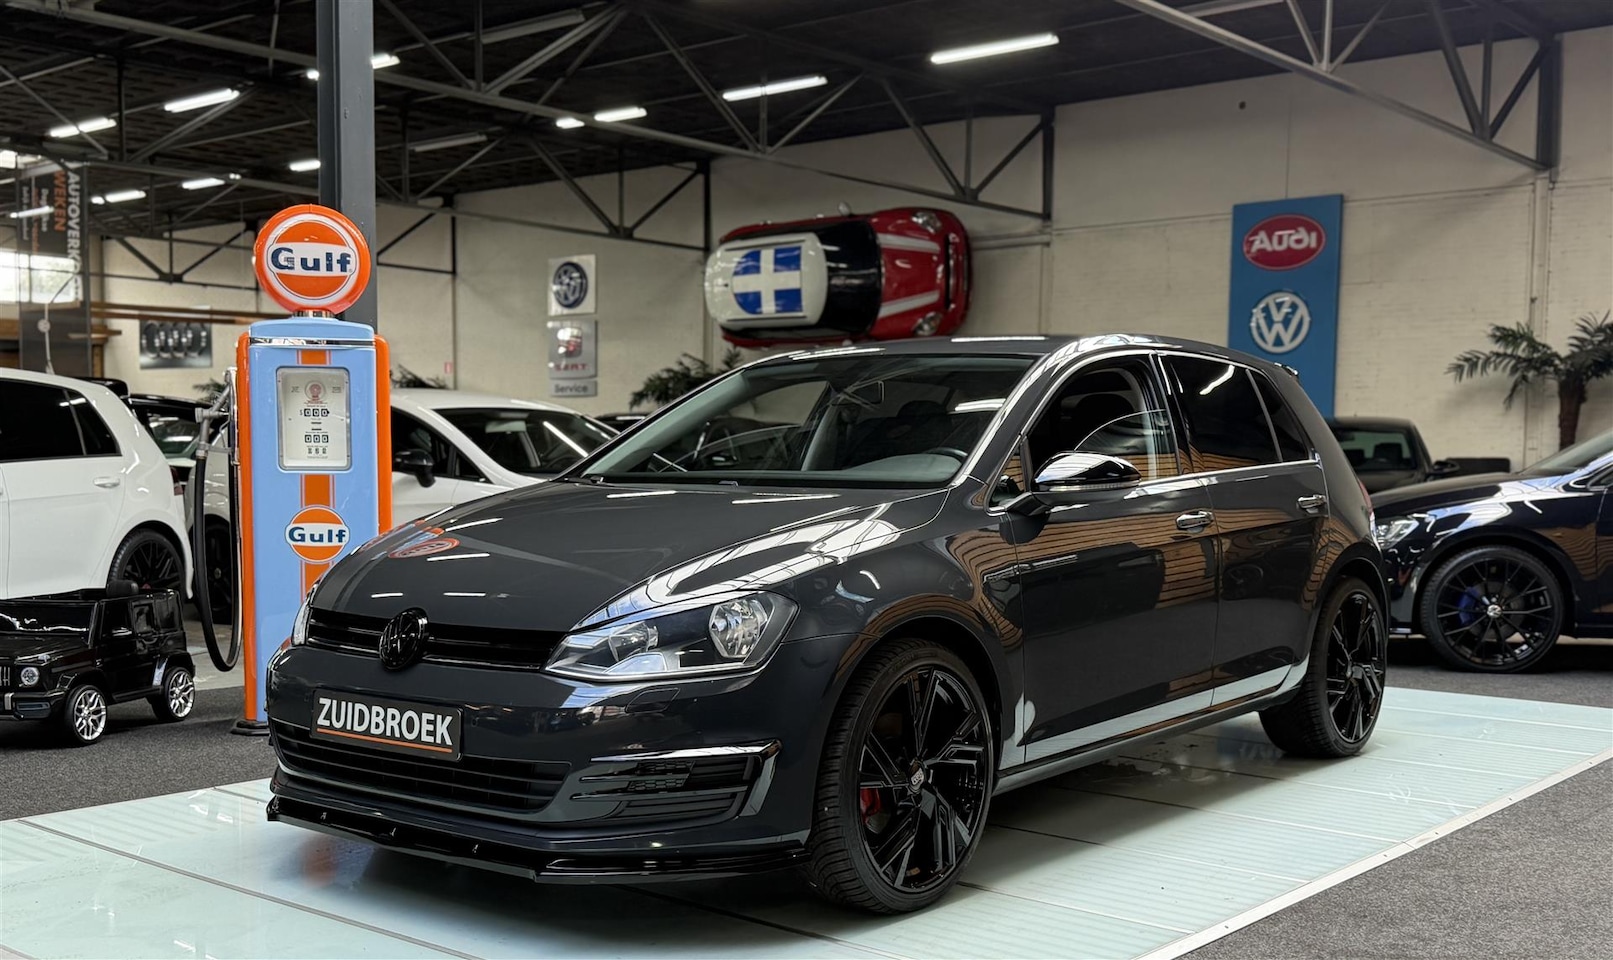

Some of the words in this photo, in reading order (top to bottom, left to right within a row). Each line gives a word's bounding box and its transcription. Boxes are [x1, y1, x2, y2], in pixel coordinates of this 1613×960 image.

[54, 169, 66, 232] WEKEN
[271, 247, 351, 272] Gulf
[554, 383, 588, 393] Service
[288, 526, 346, 543] Gulf
[317, 697, 453, 746] ZUIDBROEK
